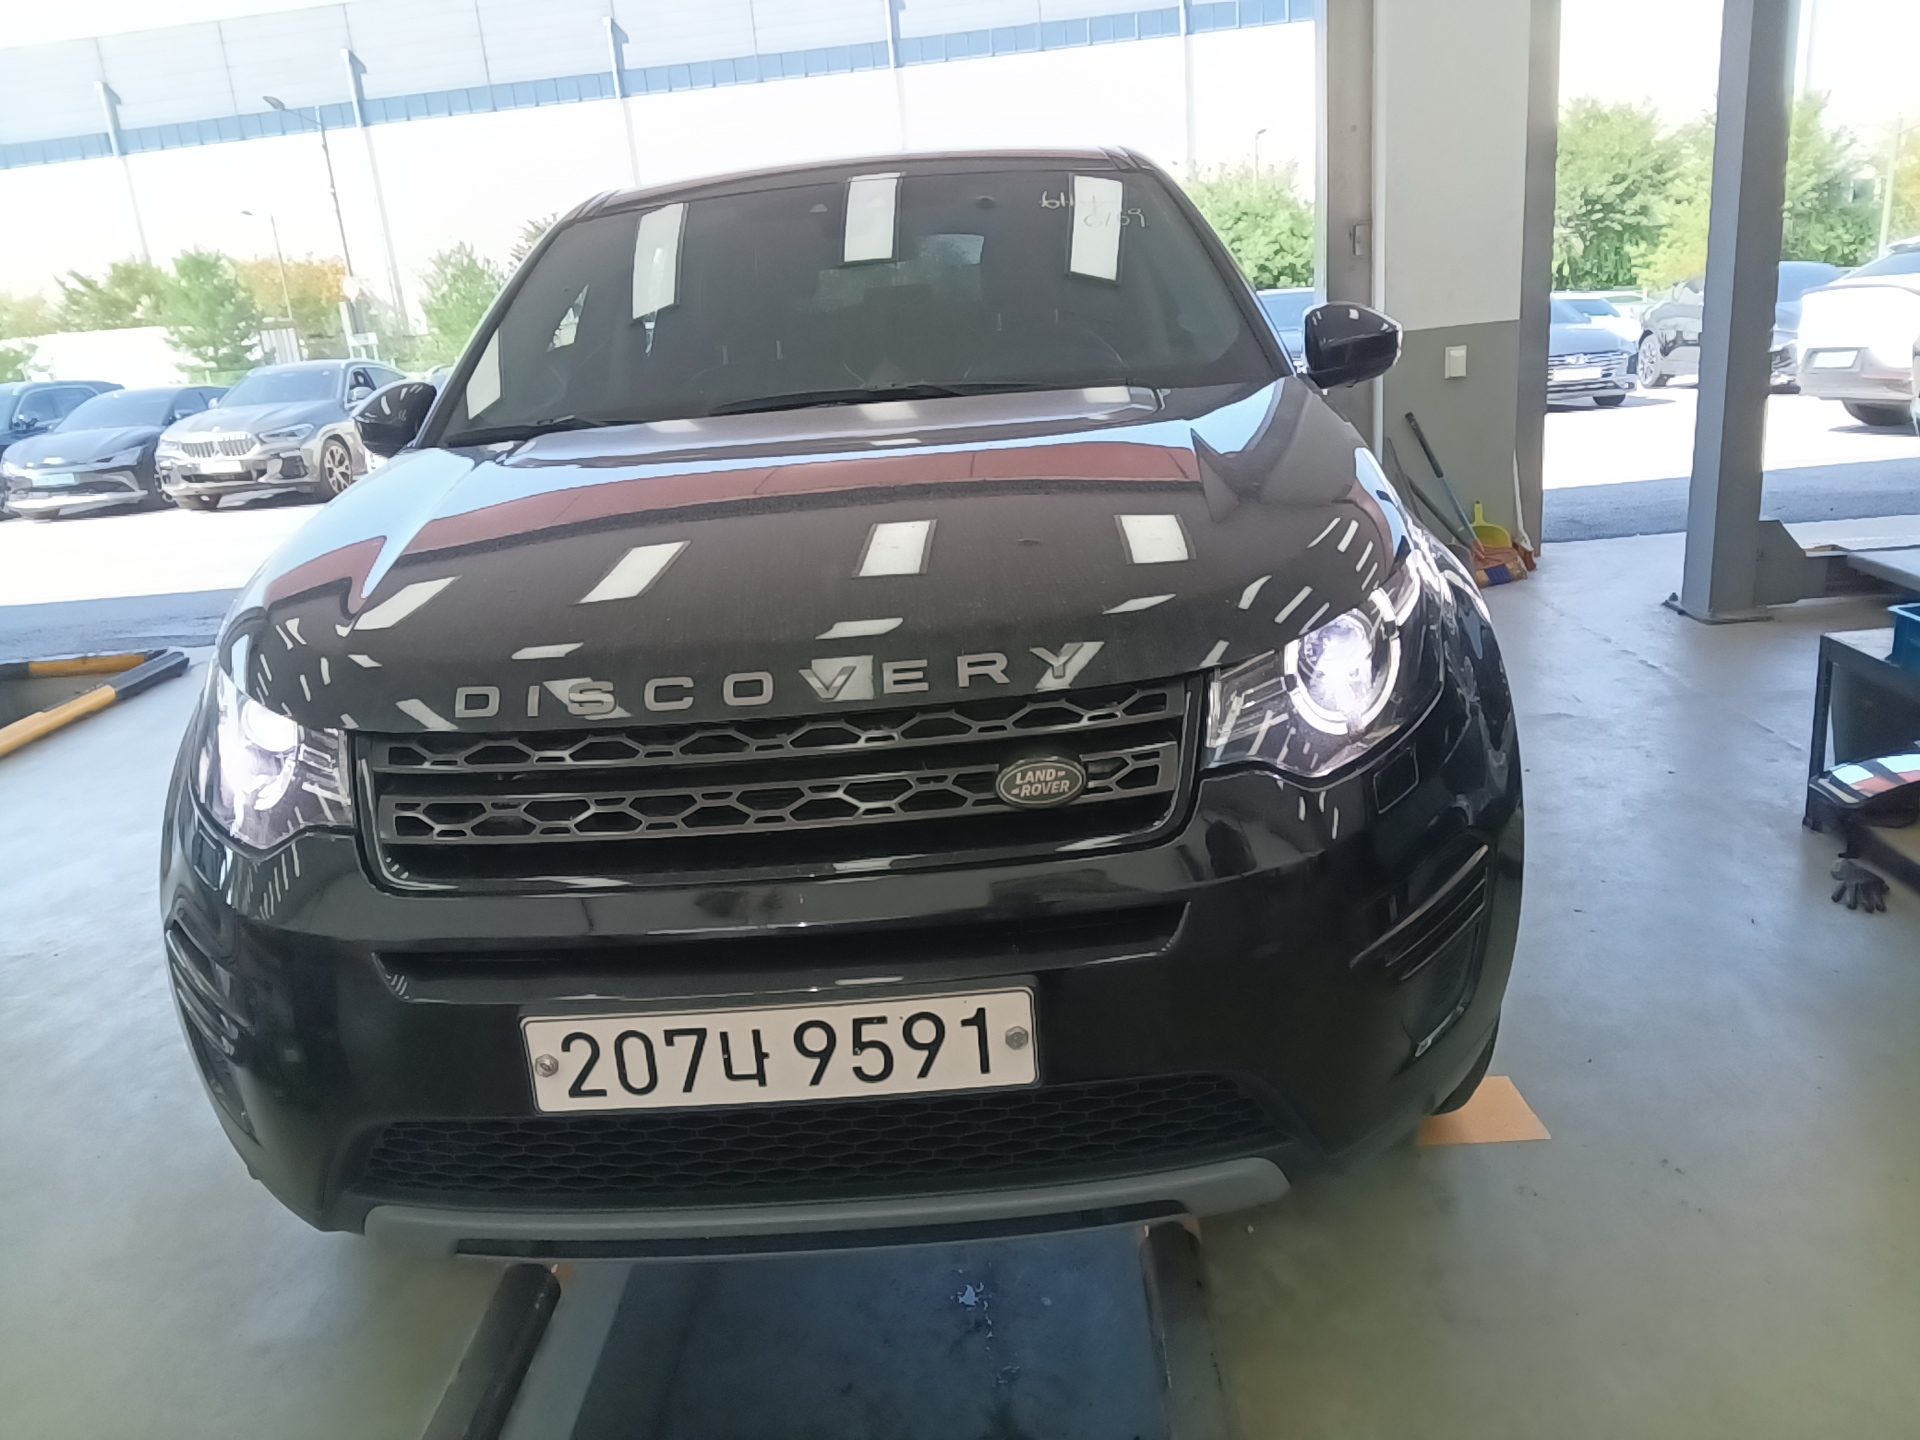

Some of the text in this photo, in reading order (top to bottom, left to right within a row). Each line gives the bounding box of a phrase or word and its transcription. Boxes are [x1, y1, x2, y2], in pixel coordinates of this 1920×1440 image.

[454, 641, 1084, 719] DISCOVERY
[561, 1007, 990, 1098] 207나 9591
